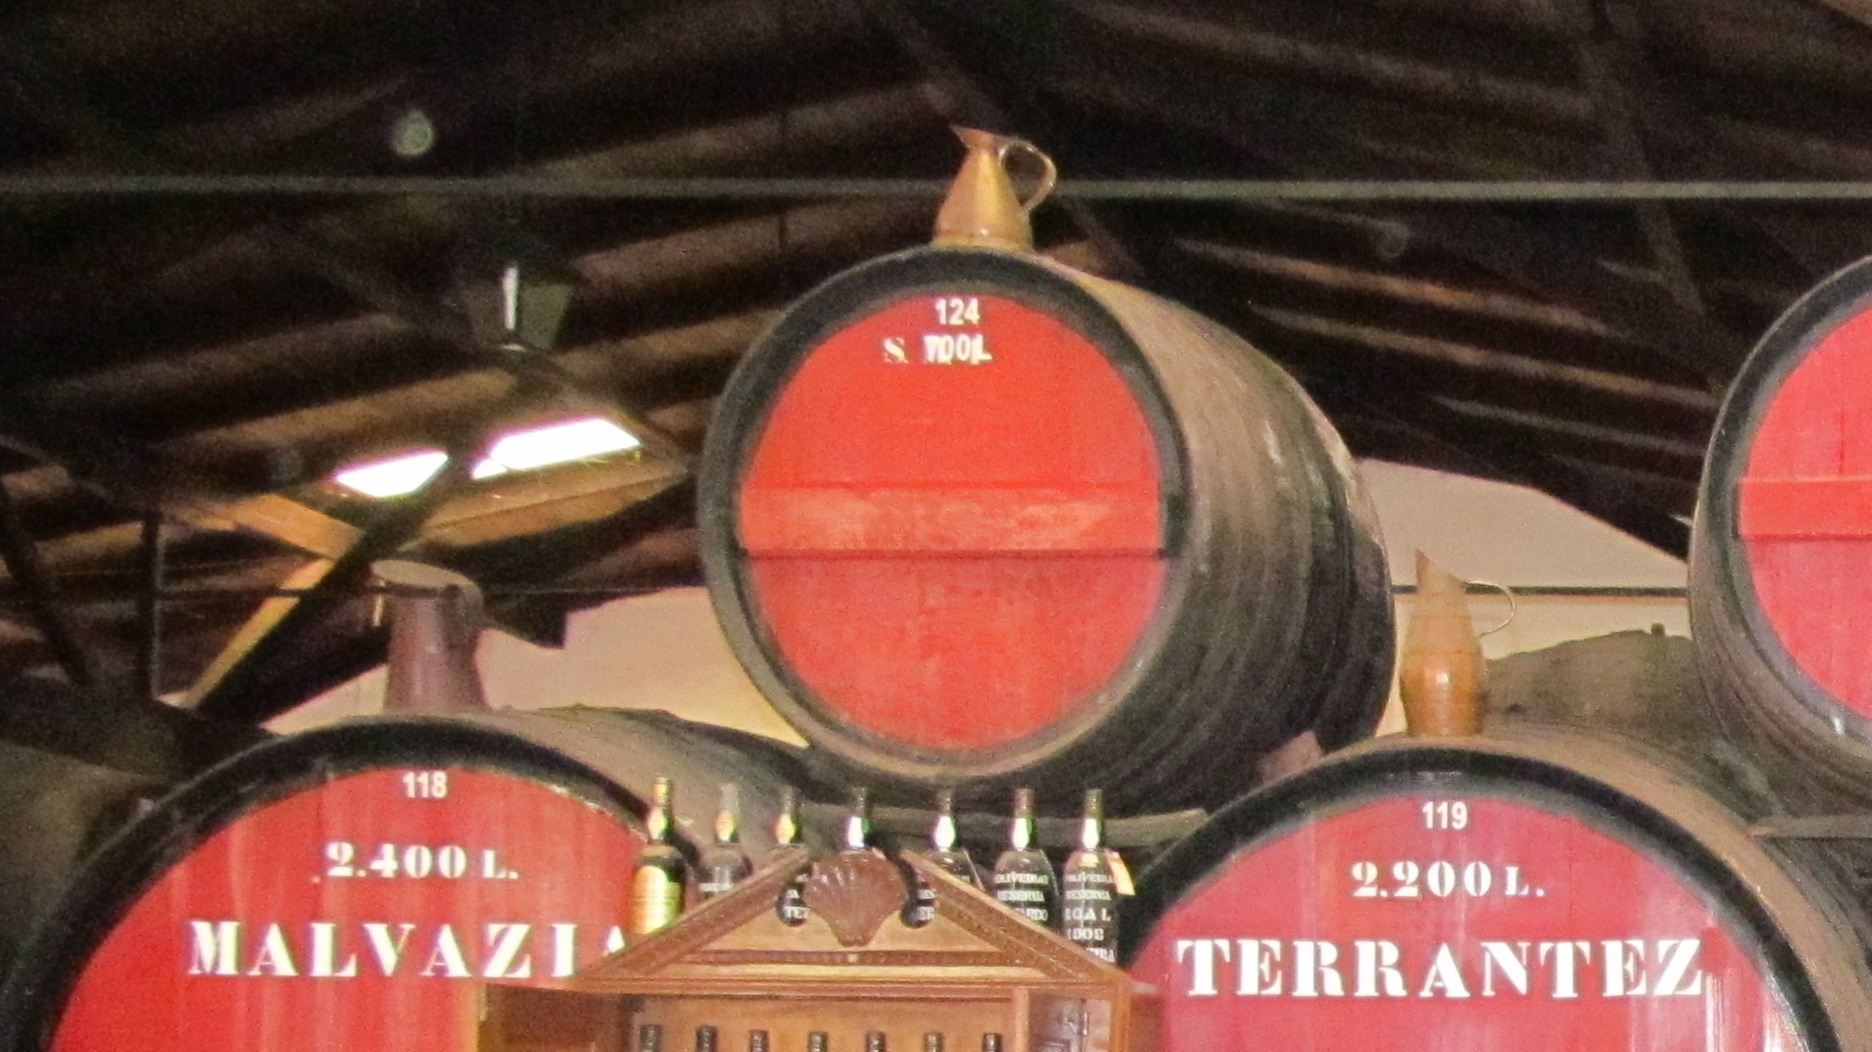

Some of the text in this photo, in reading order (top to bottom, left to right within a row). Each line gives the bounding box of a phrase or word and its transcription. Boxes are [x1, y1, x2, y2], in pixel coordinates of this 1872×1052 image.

[935, 298, 981, 325] 124
[402, 771, 448, 798] 118
[1422, 801, 1468, 829] 119
[325, 841, 468, 879] 2.400
[1351, 861, 1492, 898] 2.200
[1176, 938, 1704, 999] TERRANTEZ
